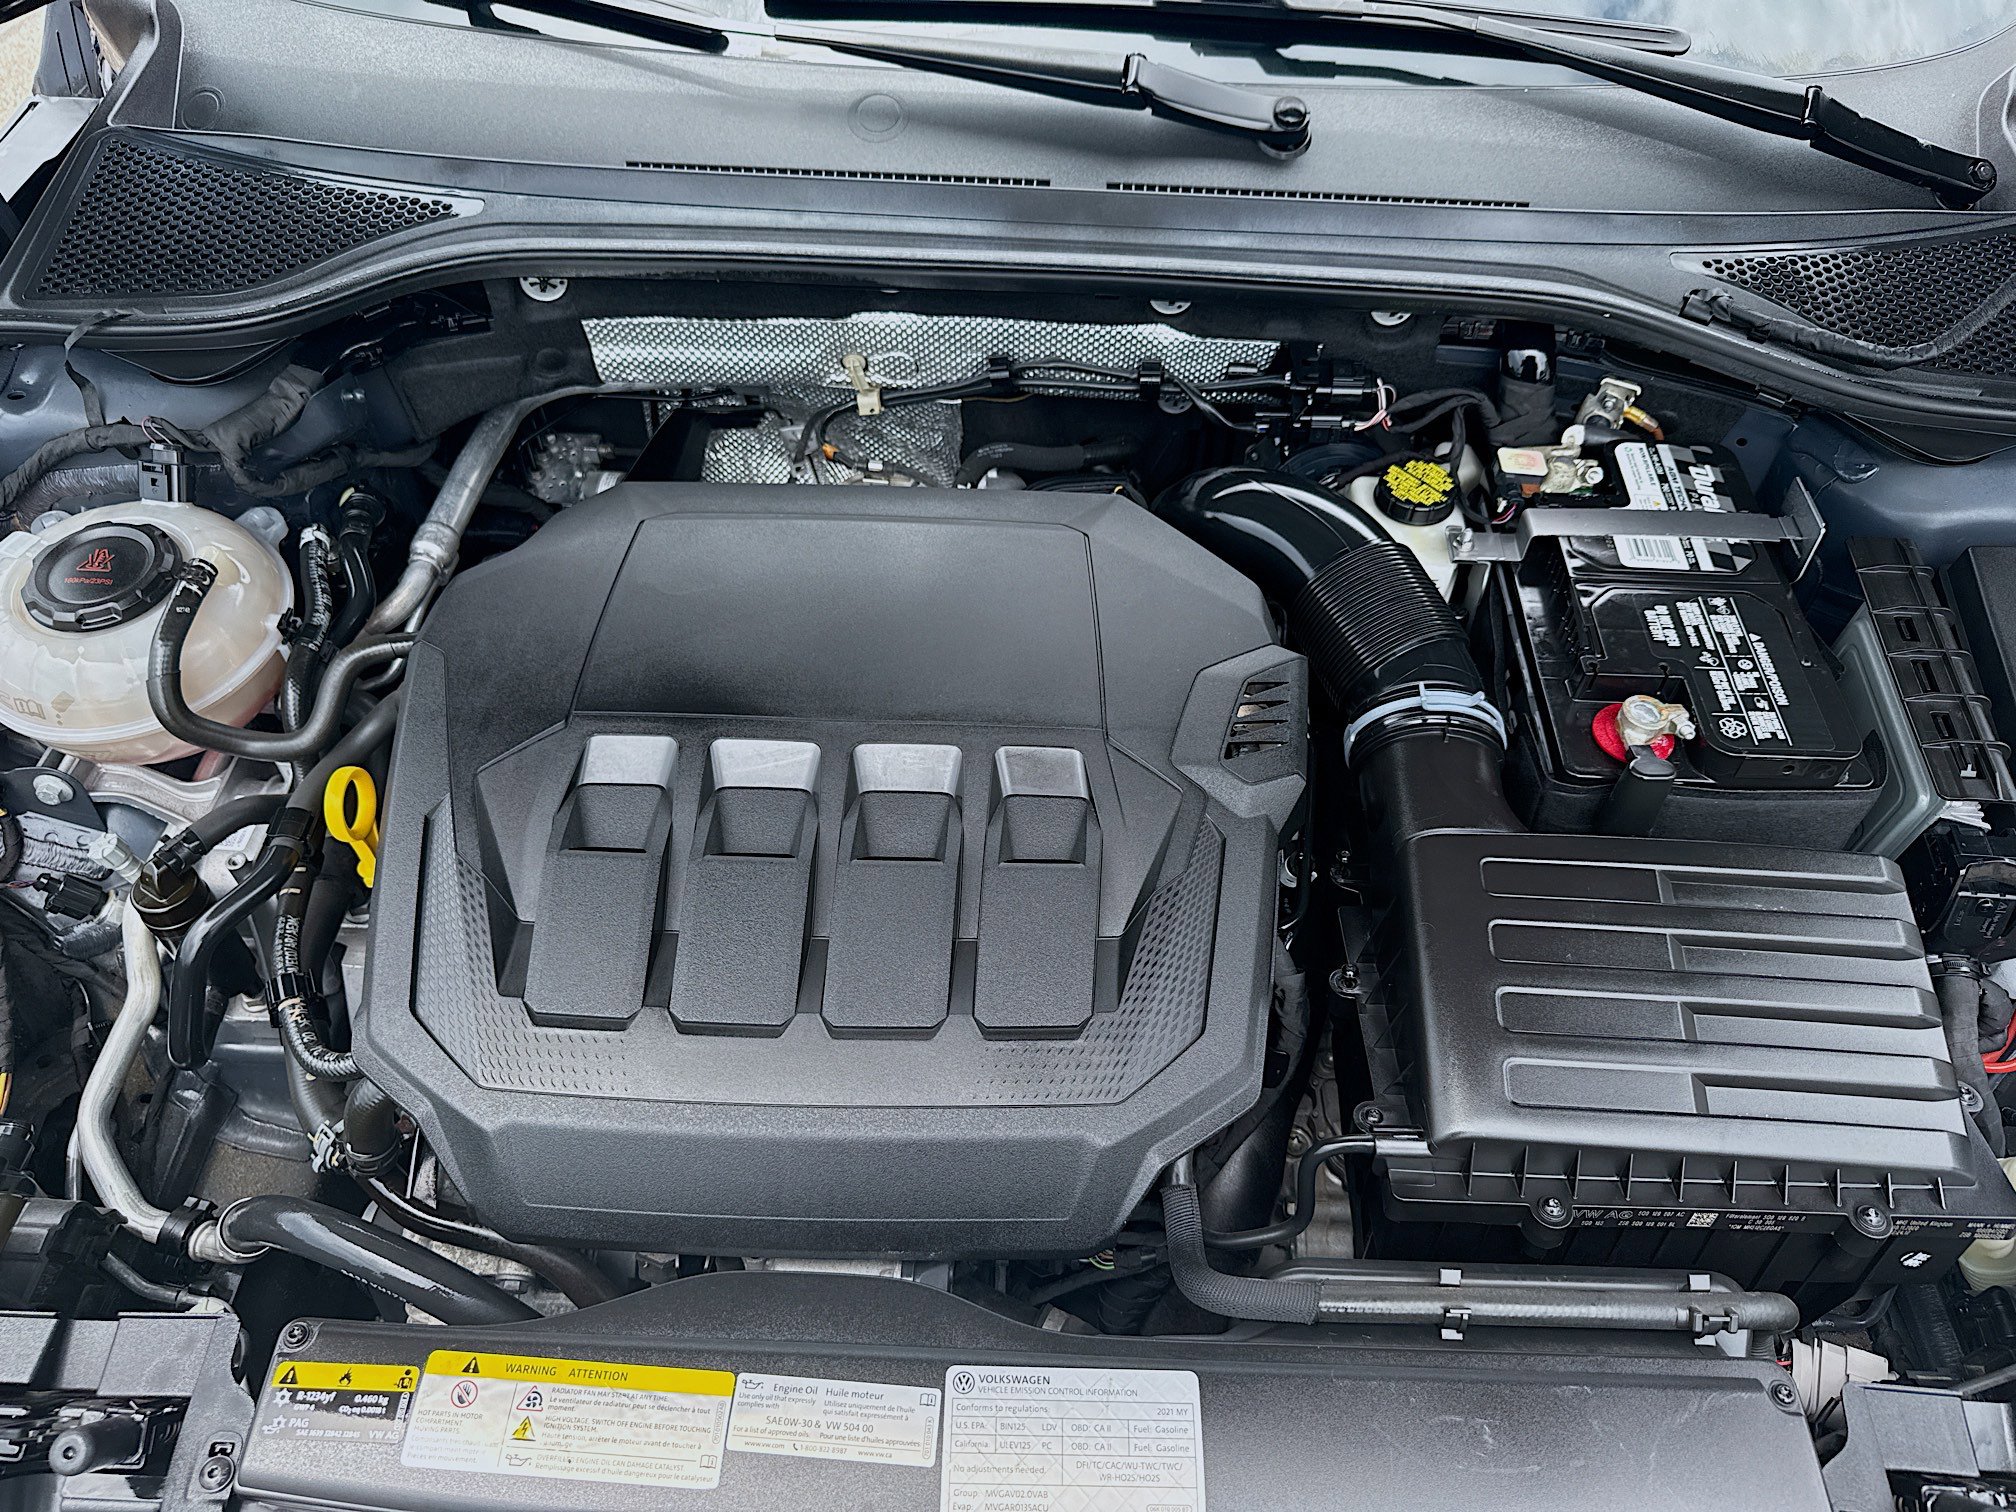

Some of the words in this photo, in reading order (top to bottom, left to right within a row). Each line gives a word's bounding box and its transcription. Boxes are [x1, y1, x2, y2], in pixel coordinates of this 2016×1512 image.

[1688, 465, 1728, 513] Dural
[1752, 642, 1790, 706] DANGER/POISON
[505, 1363, 557, 1376] WARNING
[568, 1368, 628, 1382] ATTENTION
[979, 1374, 1050, 1385] VOLKSWAGEN
[552, 1387, 582, 1396] RADIATOR
[774, 1384, 803, 1396] Engine
[805, 1385, 818, 1395] Oil
[826, 1387, 849, 1398] Huile
[852, 1390, 884, 1401] moteur
[1048, 1387, 1084, 1396] CONTROL
[1086, 1388, 1138, 1397] INFORMATION
[296, 1391, 336, 1404] R-1234yf
[354, 1394, 378, 1404] 0.460
[378, 1394, 390, 1406] kg
[750, 1393, 765, 1402] only
[774, 1394, 787, 1402] that
[788, 1395, 816, 1406] expressly
[558, 1397, 592, 1406] ventilateur
[602, 1400, 631, 1409] radiateur
[632, 1403, 647, 1411] peut
[656, 1403, 690, 1413] déclencher
[737, 1401, 765, 1410] complies
[824, 1400, 847, 1409] Utilisez
[848, 1402, 886, 1413] uniquement
[896, 1405, 916, 1414] l'huile
[432, 1410, 452, 1418] PARTS
[460, 1411, 483, 1420] MOTOR
[822, 1408, 833, 1417] qui
[834, 1409, 859, 1418] satisfait
[860, 1410, 903, 1422] expressément
[288, 1418, 309, 1427] PAG
[629, 1421, 653, 1430] ENGINE
[654, 1422, 678, 1431] BEFORE
[680, 1424, 711, 1434] TOUCHING
[814, 1419, 821, 1428] &
[826, 1421, 842, 1431] VW
[843, 1422, 860, 1432] 504
[862, 1424, 874, 1433] 00
[1000, 1422, 1026, 1431] BIN125
[368, 1430, 387, 1438] VW
[387, 1431, 399, 1440] AG
[760, 1427, 767, 1435] of
[768, 1429, 797, 1439] approved
[1155, 1426, 1189, 1434] Gasoline
[619, 1438, 642, 1446] moteur
[672, 1440, 696, 1449] toucher
[820, 1433, 833, 1441] Pour
[848, 1434, 860, 1442] liste
[860, 1435, 884, 1445] d'huiles
[1000, 1441, 1031, 1449] ULEV125
[744, 1440, 785, 1450] www.vw.com
[858, 1450, 893, 1459] www.vw.ca
[1156, 1444, 1190, 1452] Gasoline
[627, 1460, 654, 1469] DAMAGE
[967, 1465, 1013, 1474] adjustments
[535, 1463, 574, 1473] Remplissage
[576, 1466, 600, 1474] excessif
[624, 1470, 656, 1479] dangereux
[658, 1473, 673, 1481] pour
